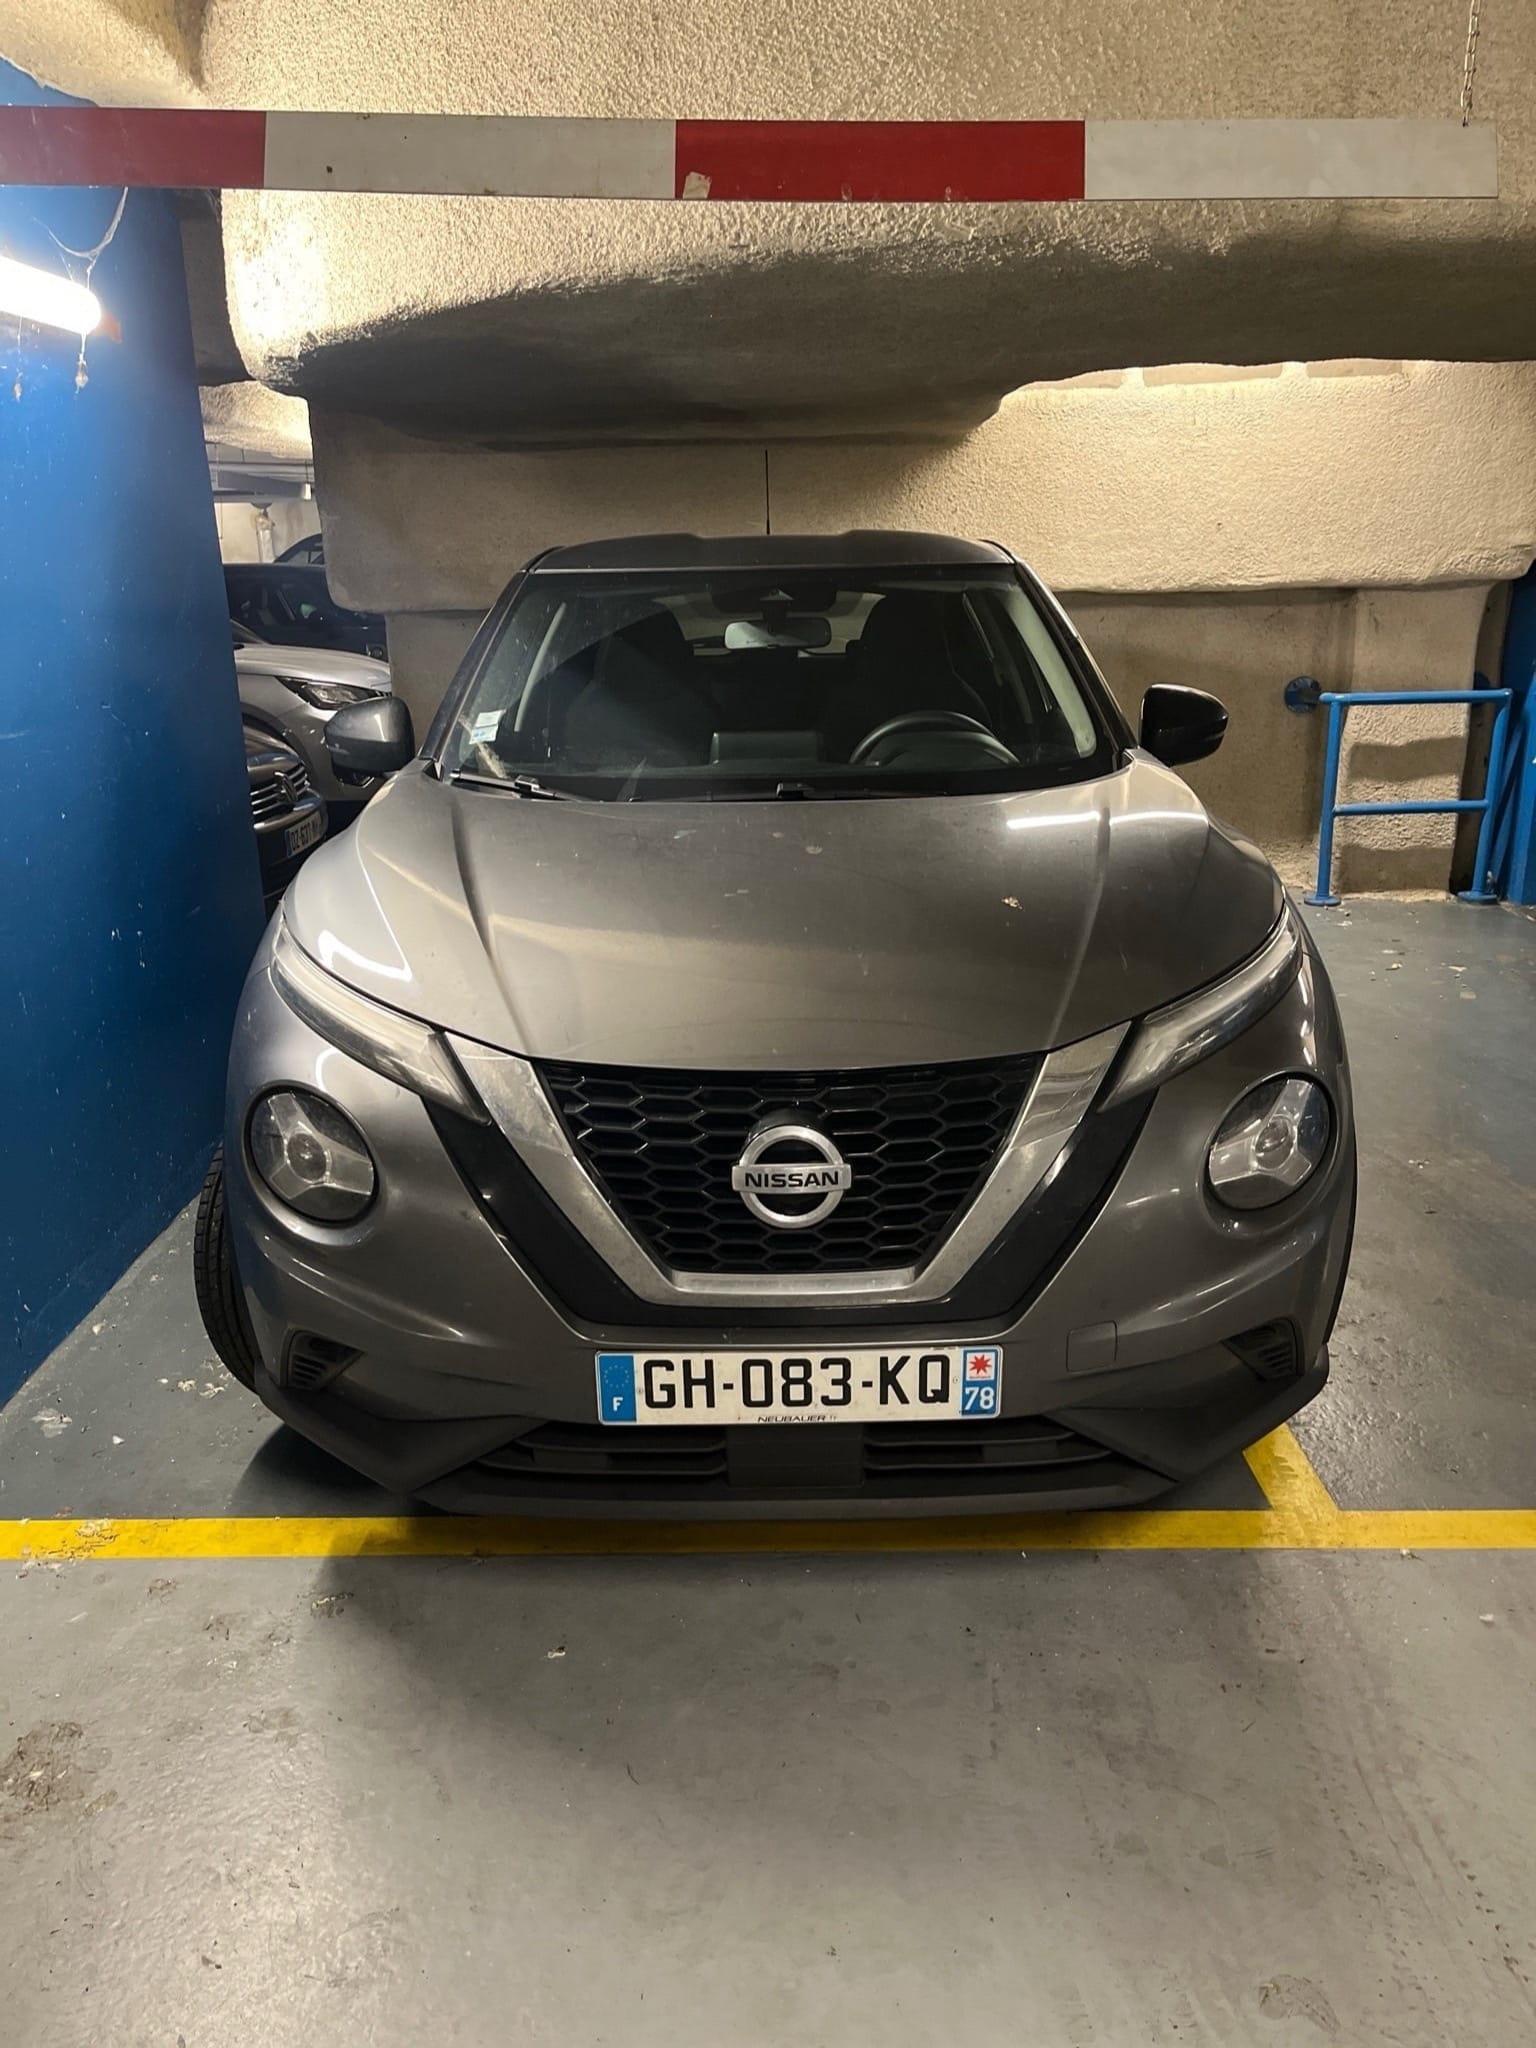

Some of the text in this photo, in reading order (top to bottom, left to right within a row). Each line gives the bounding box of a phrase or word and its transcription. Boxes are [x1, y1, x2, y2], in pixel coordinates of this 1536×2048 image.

[745, 1171, 839, 1188] NISSAN
[643, 1354, 950, 1408] GH-083-KQ
[612, 1397, 624, 1412] F
[965, 1386, 995, 1410] 78
